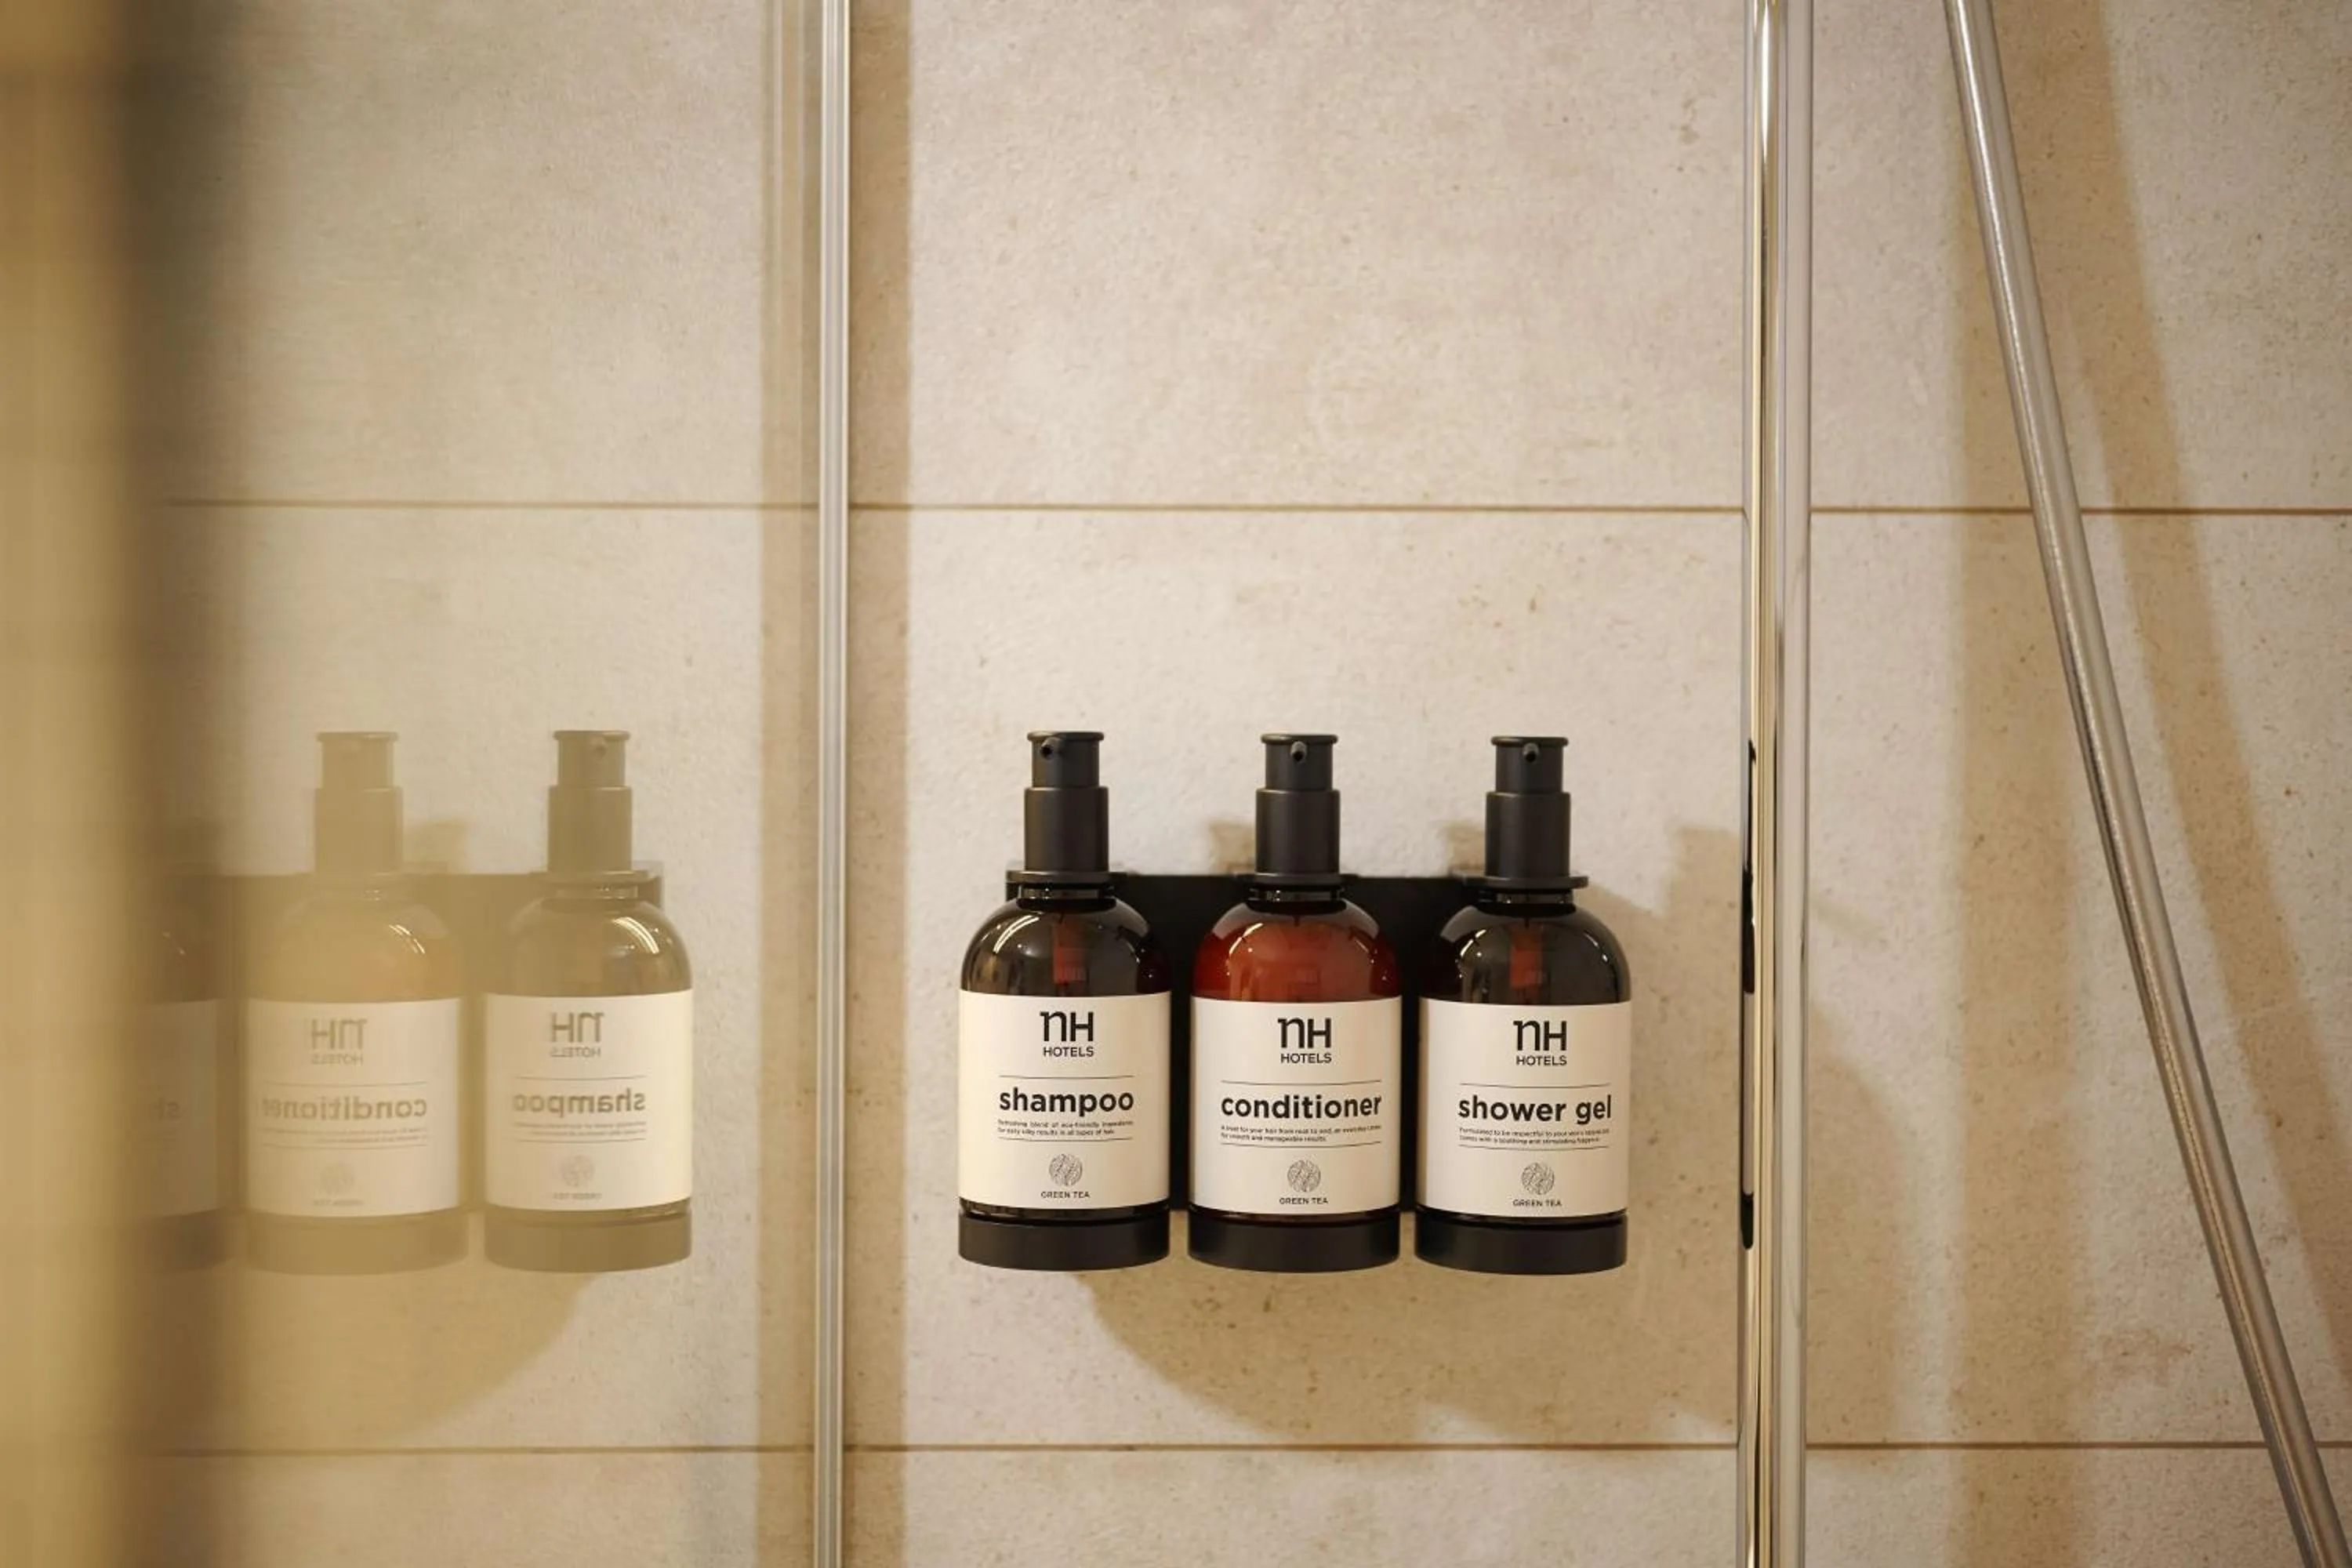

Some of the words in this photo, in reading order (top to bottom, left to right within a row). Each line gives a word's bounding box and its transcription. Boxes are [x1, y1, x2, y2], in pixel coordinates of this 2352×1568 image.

[1043, 1047, 1094, 1058] HOTELS
[1280, 1053, 1332, 1064] HOTELS
[1516, 1055, 1567, 1066] HOTELS
[1000, 1087, 1134, 1117] shampoo
[1221, 1094, 1382, 1119] conditioner
[1458, 1094, 1566, 1121] shower
[1576, 1094, 1611, 1125] gel
[1041, 1191, 1071, 1200] GREEN
